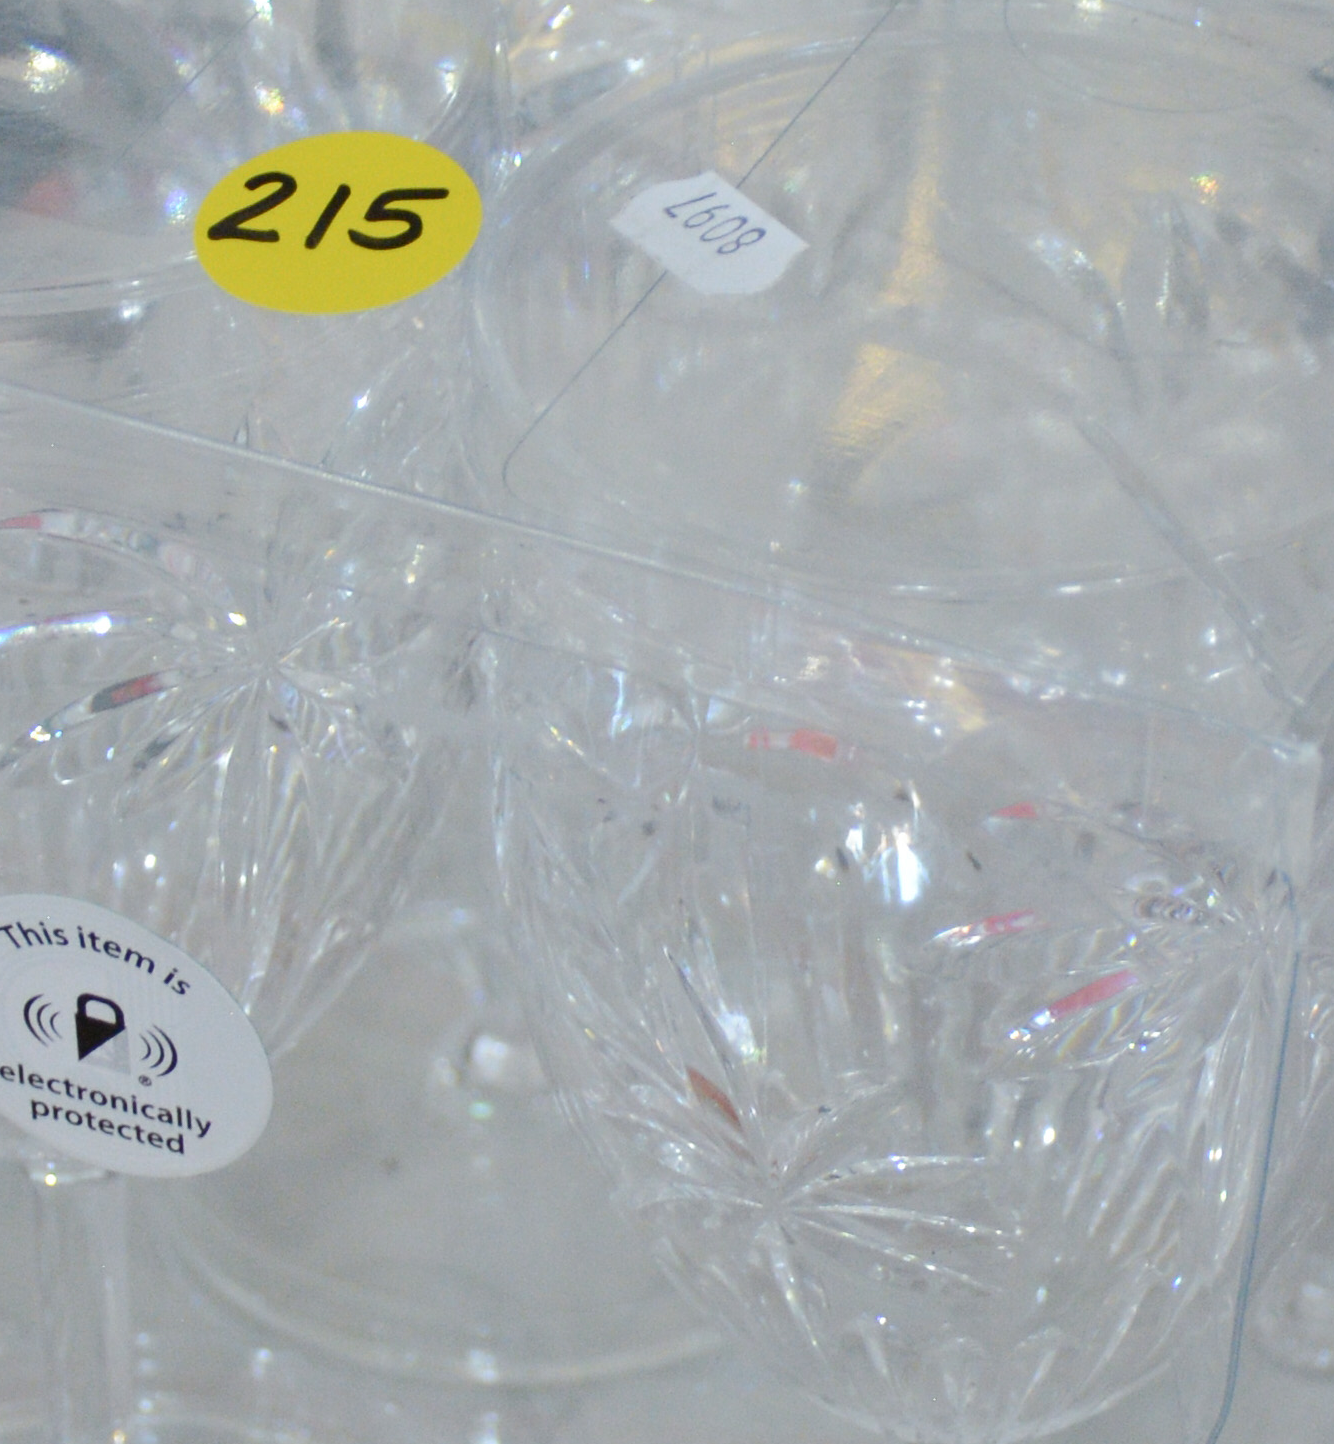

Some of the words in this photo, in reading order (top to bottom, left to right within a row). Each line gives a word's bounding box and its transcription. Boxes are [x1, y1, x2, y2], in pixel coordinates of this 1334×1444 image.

[206, 171, 450, 251] 215
[77, 925, 156, 974] item
[163, 968, 191, 995] is
[30, 1098, 185, 1155] protected
